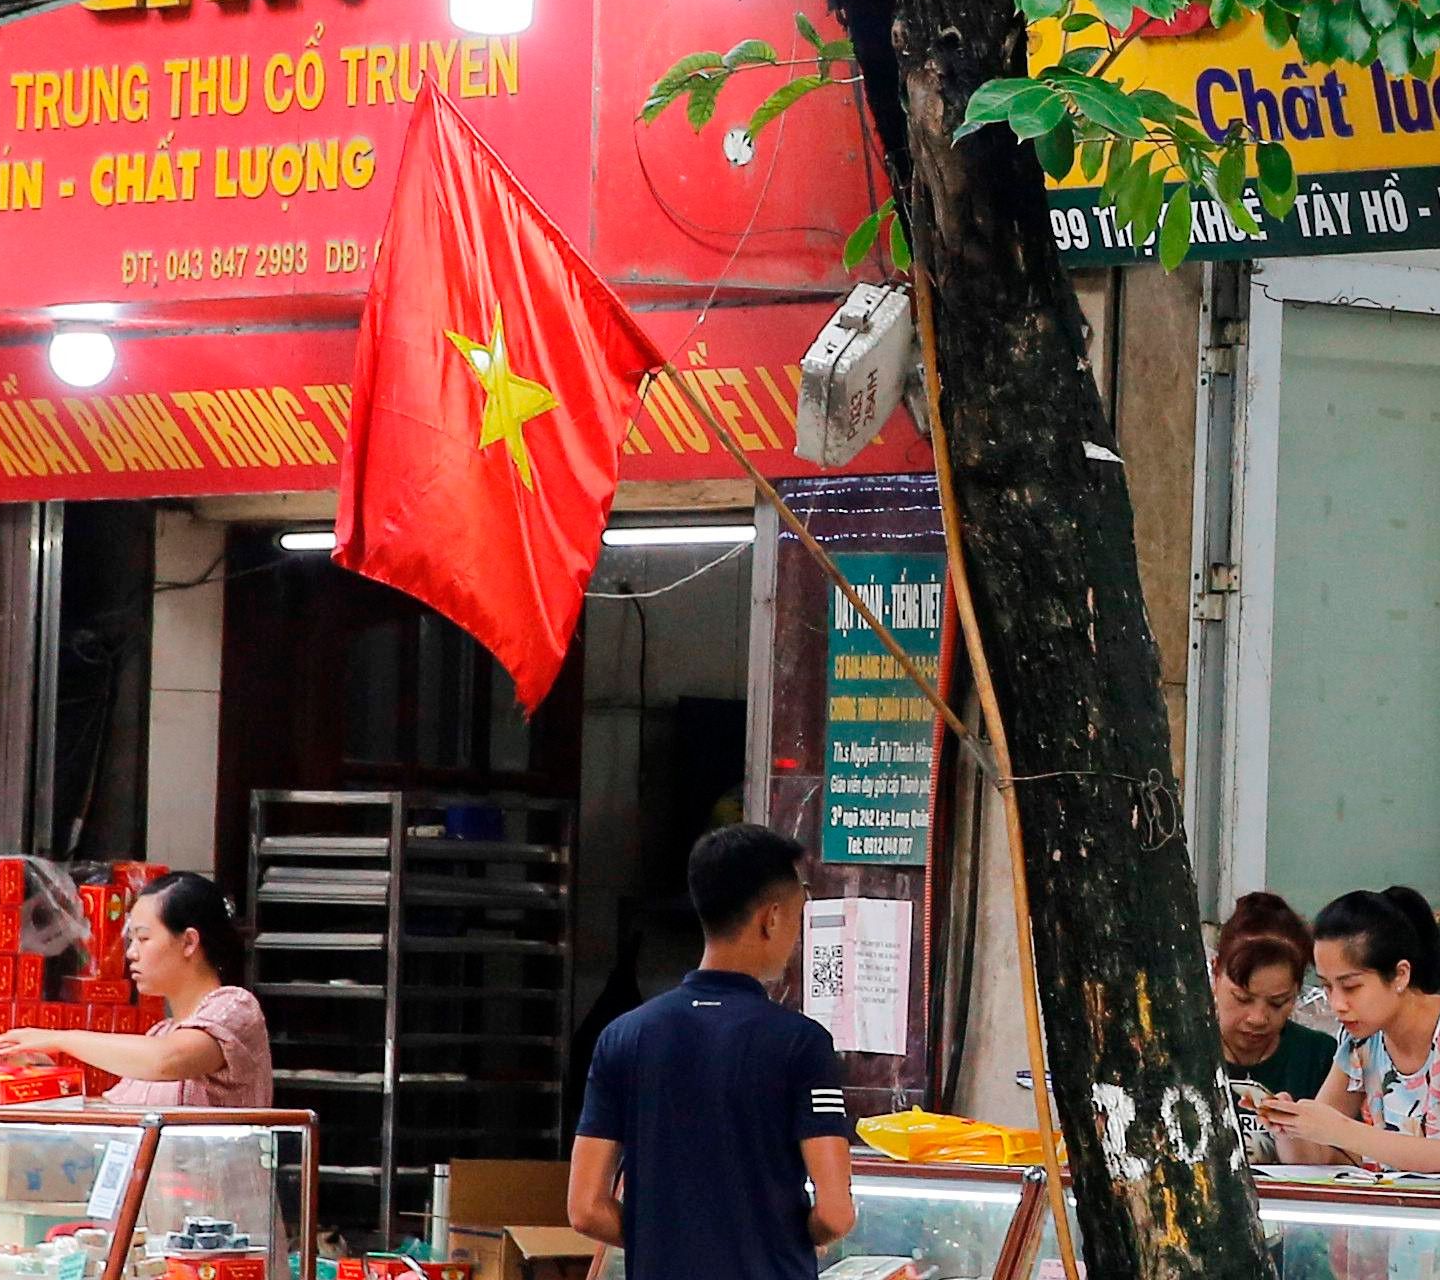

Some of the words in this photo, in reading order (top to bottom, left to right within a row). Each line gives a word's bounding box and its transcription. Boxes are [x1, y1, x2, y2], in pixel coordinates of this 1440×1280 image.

[10, 61, 151, 132] TRUNG
[164, 56, 253, 120] THU
[271, 21, 327, 113] CỔ
[90, 130, 198, 207] CHẤT
[215, 136, 376, 213] LƯỢNG
[1296, 183, 1351, 240] TÂY
[1364, 172, 1410, 235] HỒ
[165, 250, 203, 282] 043
[209, 247, 248, 278] 847
[253, 243, 309, 277] 2993
[169, 385, 322, 471] TRUNG
[891, 567, 919, 630] TIẾNG
[921, 573, 942, 640] VIỆT
